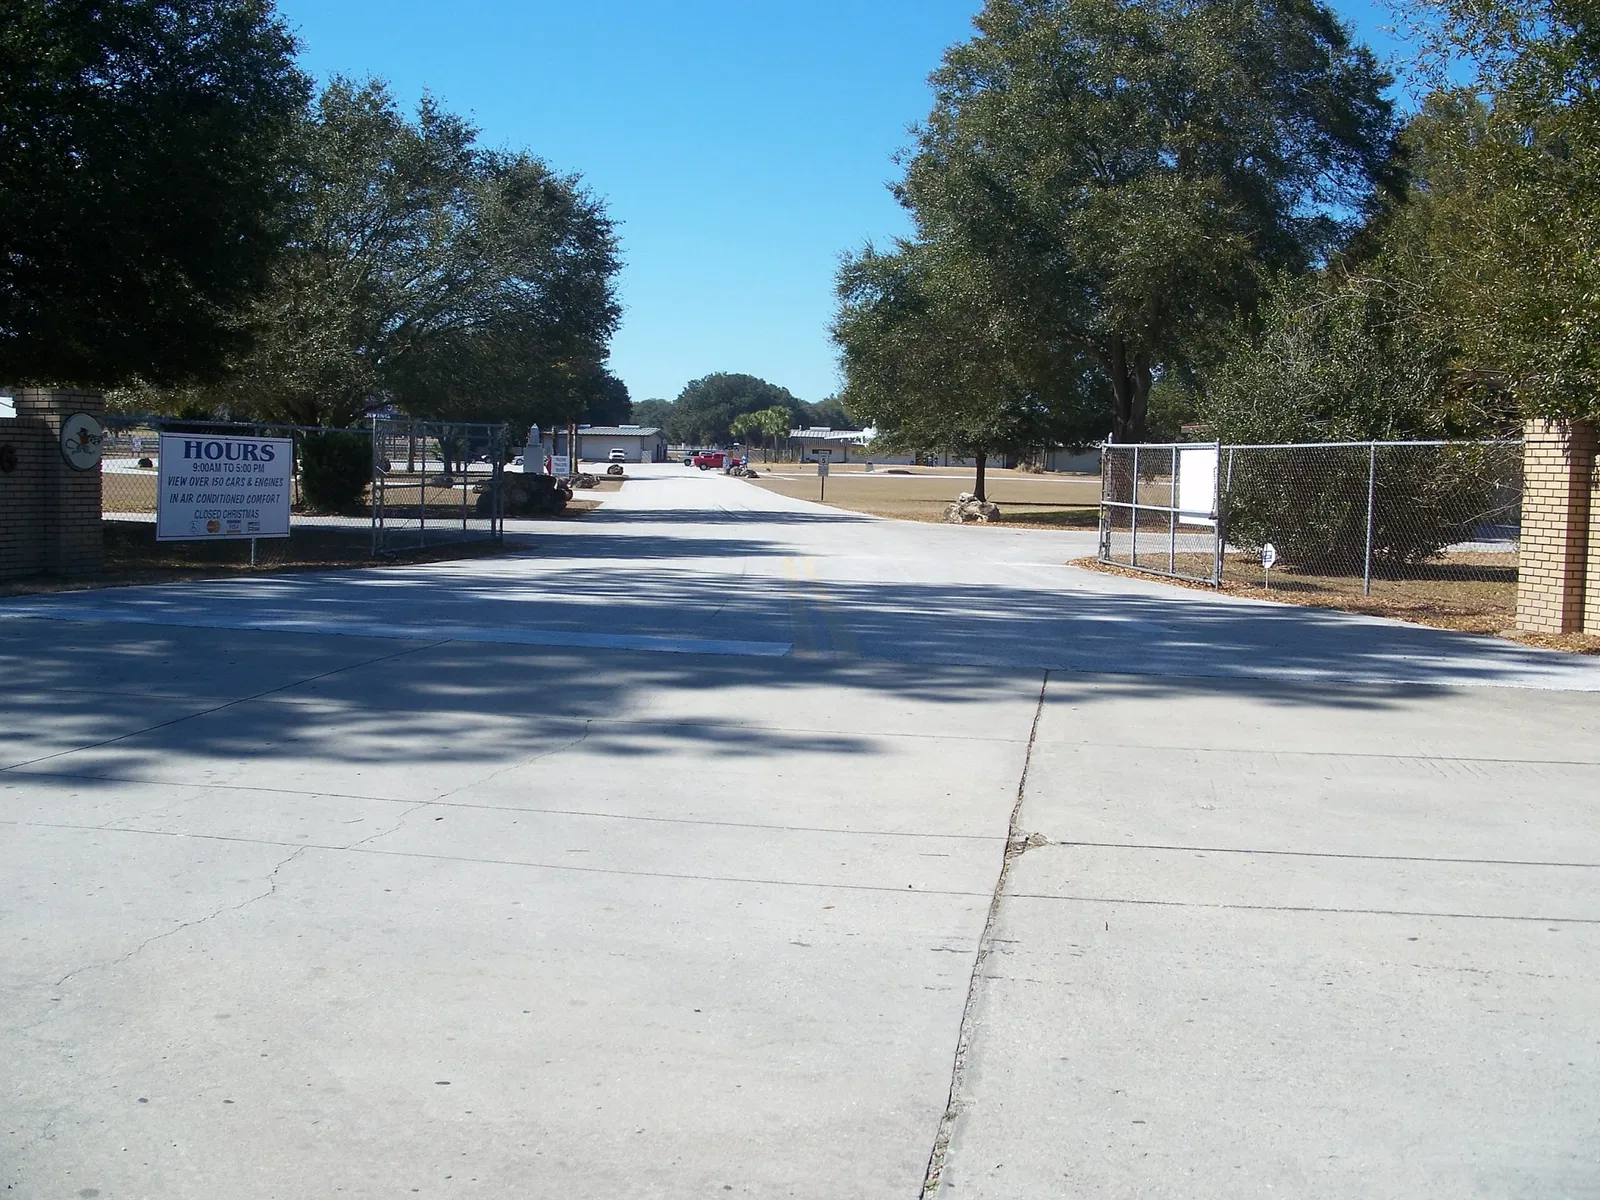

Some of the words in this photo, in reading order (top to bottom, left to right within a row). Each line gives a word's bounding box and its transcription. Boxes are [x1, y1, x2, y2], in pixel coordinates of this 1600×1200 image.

[183, 440, 275, 462] HOURS
[192, 462, 222, 473] 9:00AM
[223, 462, 235, 473] TO
[235, 463, 252, 473] 5:00
[253, 463, 265, 474] PM
[168, 476, 188, 487] VIEW
[189, 476, 210, 487] OVER
[211, 477, 225, 487] 150
[225, 477, 246, 487] CARS
[246, 477, 253, 487] &
[254, 477, 284, 487] ENGINES
[169, 493, 180, 504] IN
[180, 493, 194, 504] AIR
[196, 493, 245, 504] CONDITIONED
[246, 494, 280, 504] COMFORT
[194, 509, 222, 519] CLOSED
[222, 509, 260, 519] CHRISTMAS
